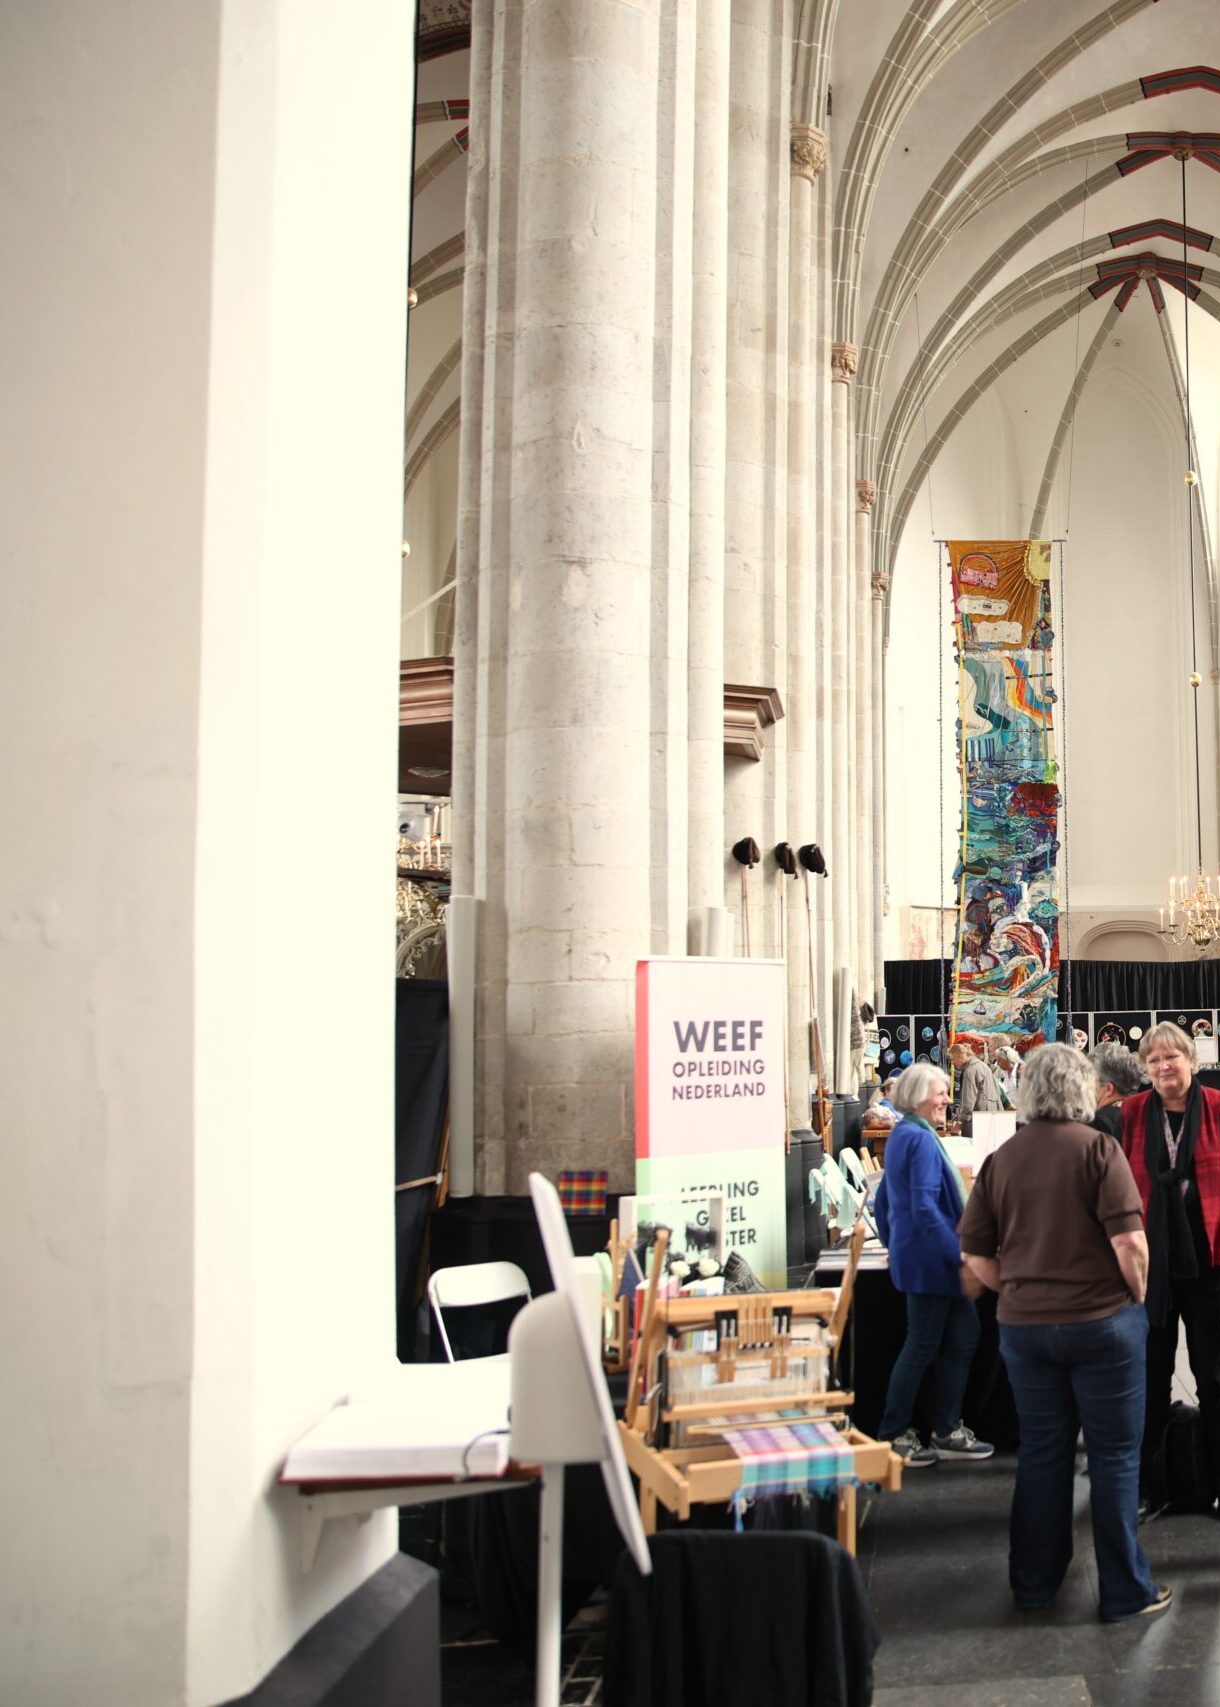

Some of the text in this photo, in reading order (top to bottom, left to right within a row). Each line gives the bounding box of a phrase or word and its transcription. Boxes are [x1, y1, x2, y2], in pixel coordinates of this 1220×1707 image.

[672, 1020, 763, 1053] WEEF
[672, 1058, 765, 1078] OPLEIDING
[672, 1082, 766, 1101] NEDERLAND
[696, 1206, 746, 1226] GEL
